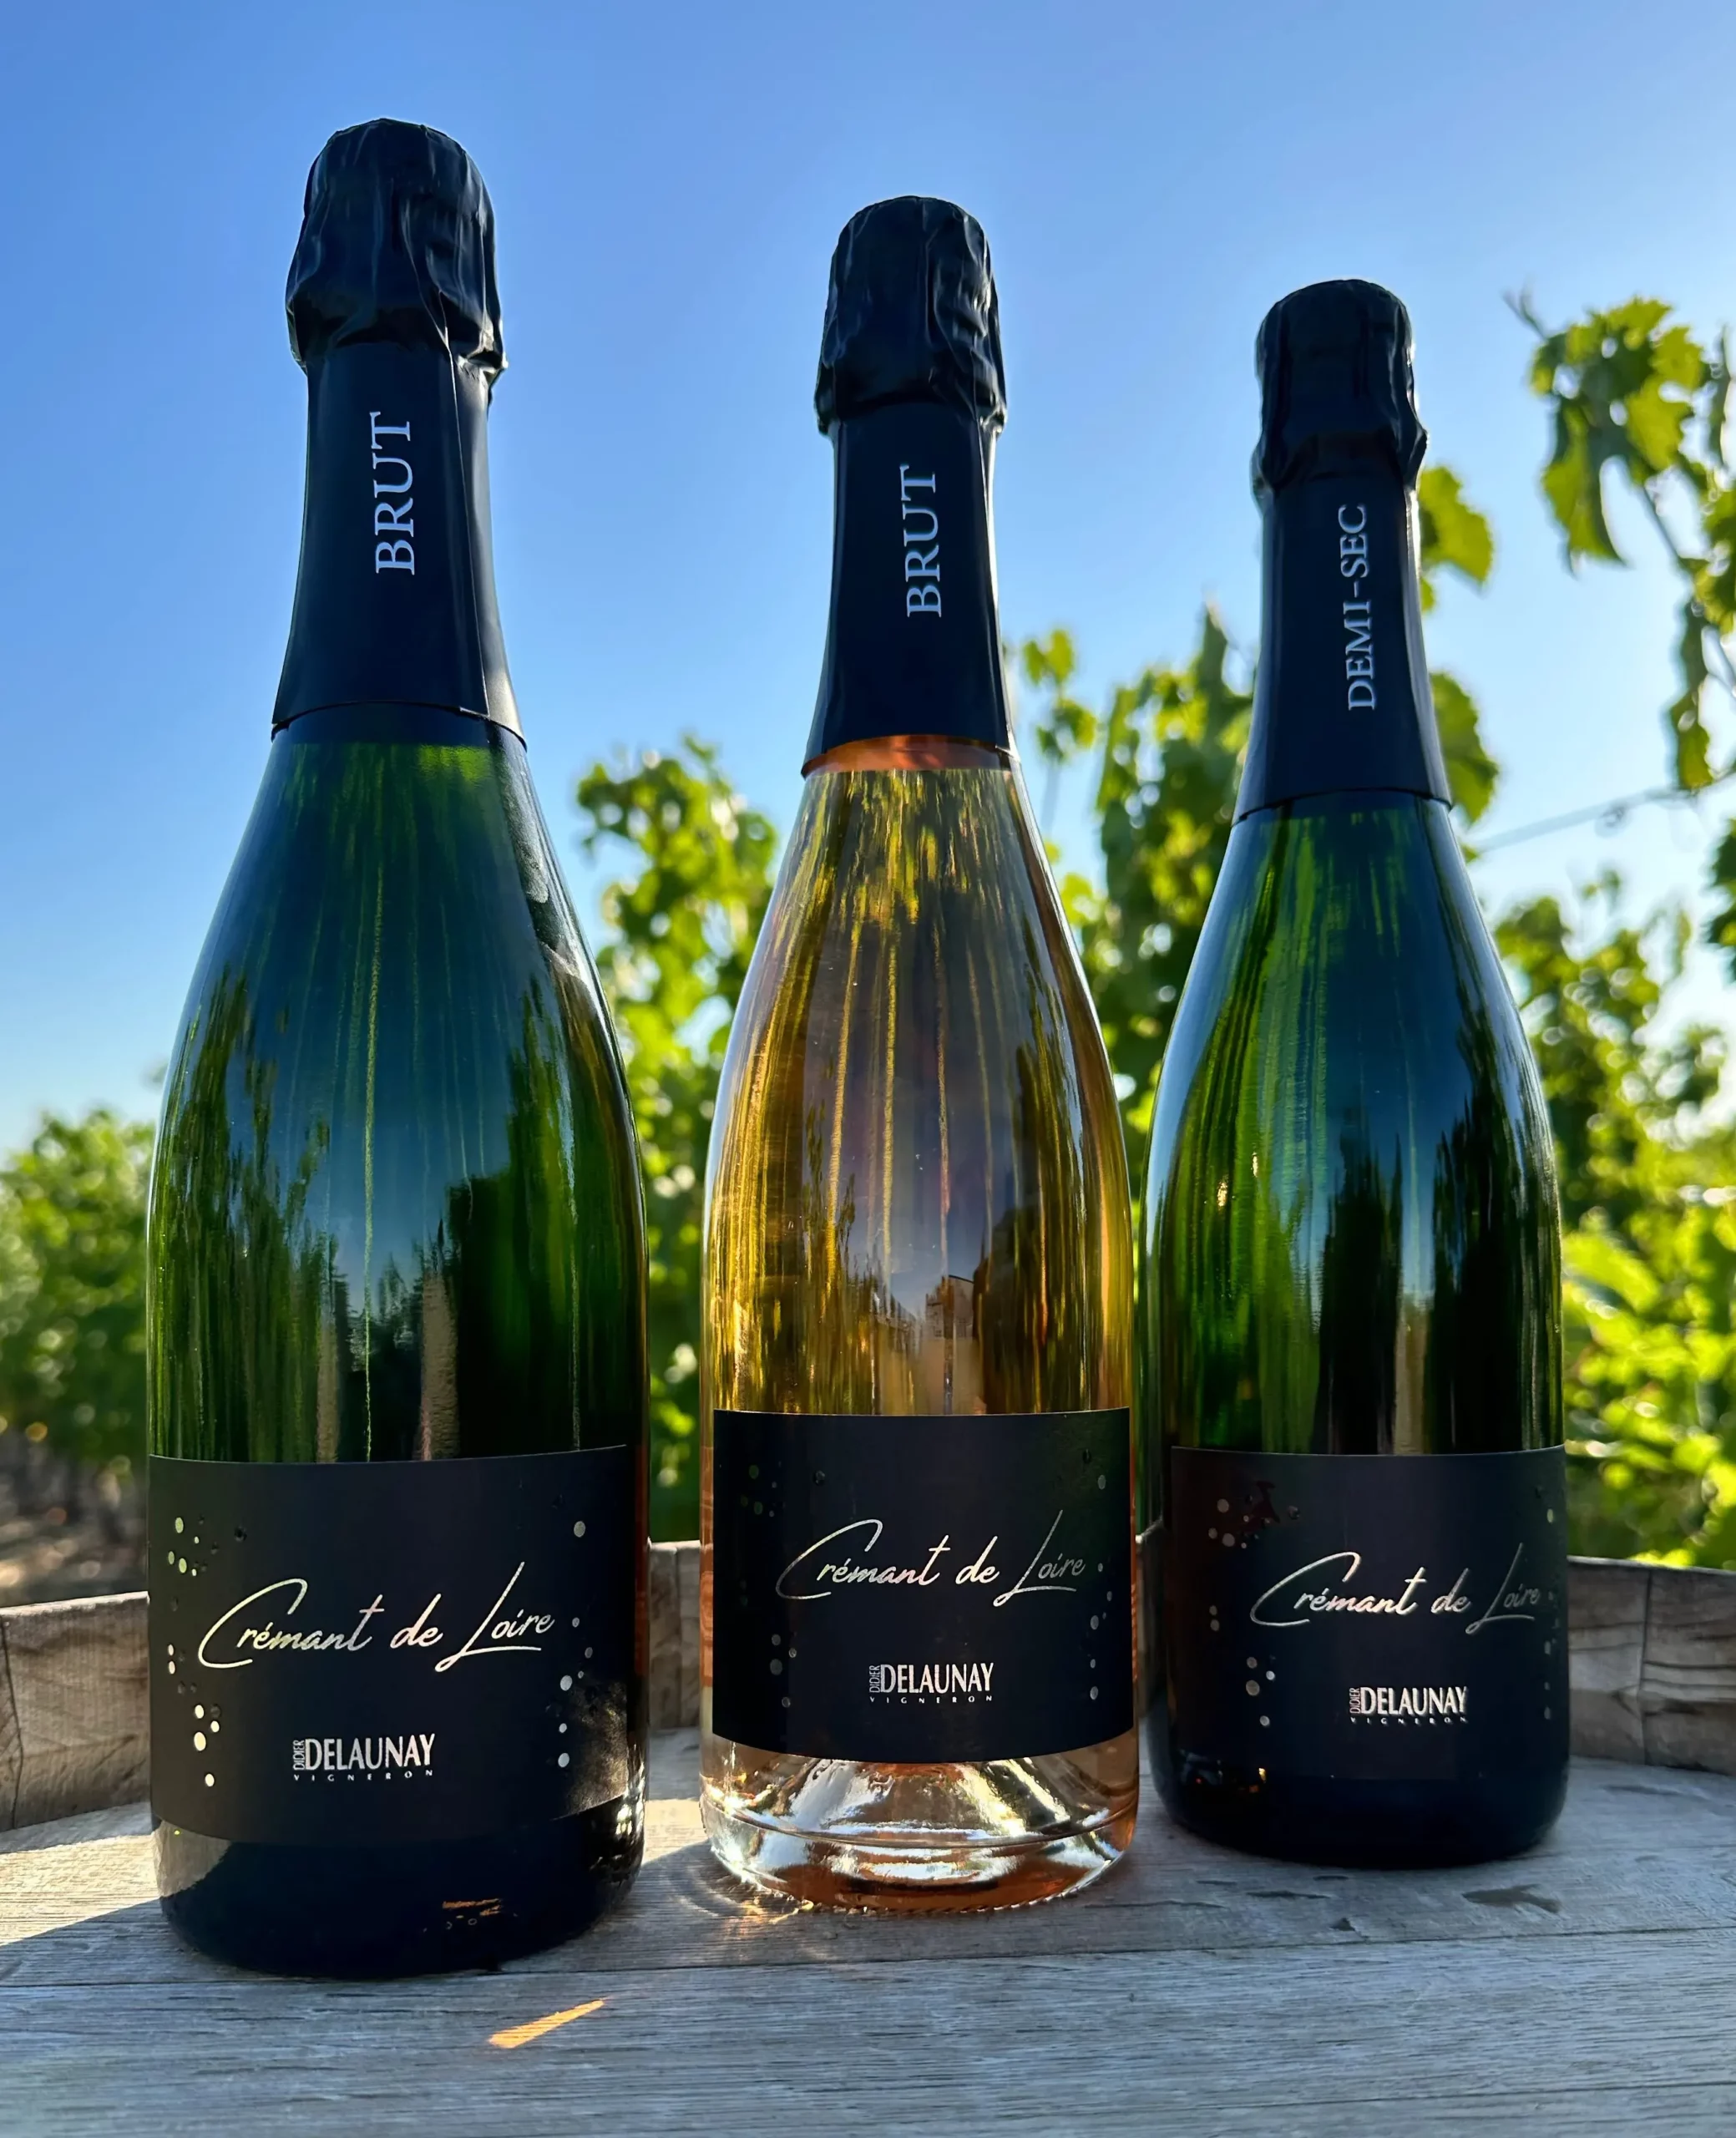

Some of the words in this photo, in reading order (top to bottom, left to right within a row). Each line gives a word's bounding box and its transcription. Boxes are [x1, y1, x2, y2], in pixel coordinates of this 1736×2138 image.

[369, 411, 415, 575] BRUT
[899, 464, 942, 617] BRUT
[1338, 504, 1376, 711] DEMI-SEC
[776, 1518, 950, 1600] Crémant
[955, 1536, 1000, 1585] de
[993, 1509, 1086, 1607] Loire
[1250, 1551, 1427, 1627] Crémant
[1430, 1568, 1472, 1614] de
[1465, 1543, 1541, 1634] Loire
[198, 1578, 385, 1669] Crémant
[389, 1593, 443, 1649] de
[435, 1561, 555, 1673] Loire
[869, 1664, 881, 1694] DIDIER
[880, 1662, 994, 1695] DELAUNAY
[869, 1695, 992, 1704] VIGNERON
[1349, 1688, 1360, 1714] DIDIER
[1359, 1686, 1468, 1715] DELAUNAY
[1350, 1716, 1469, 1725] VIGNERON
[292, 1740, 305, 1771] DIDIER
[305, 1733, 435, 1771] DELAUNAY
[294, 1769, 433, 1781] VIGNERON
